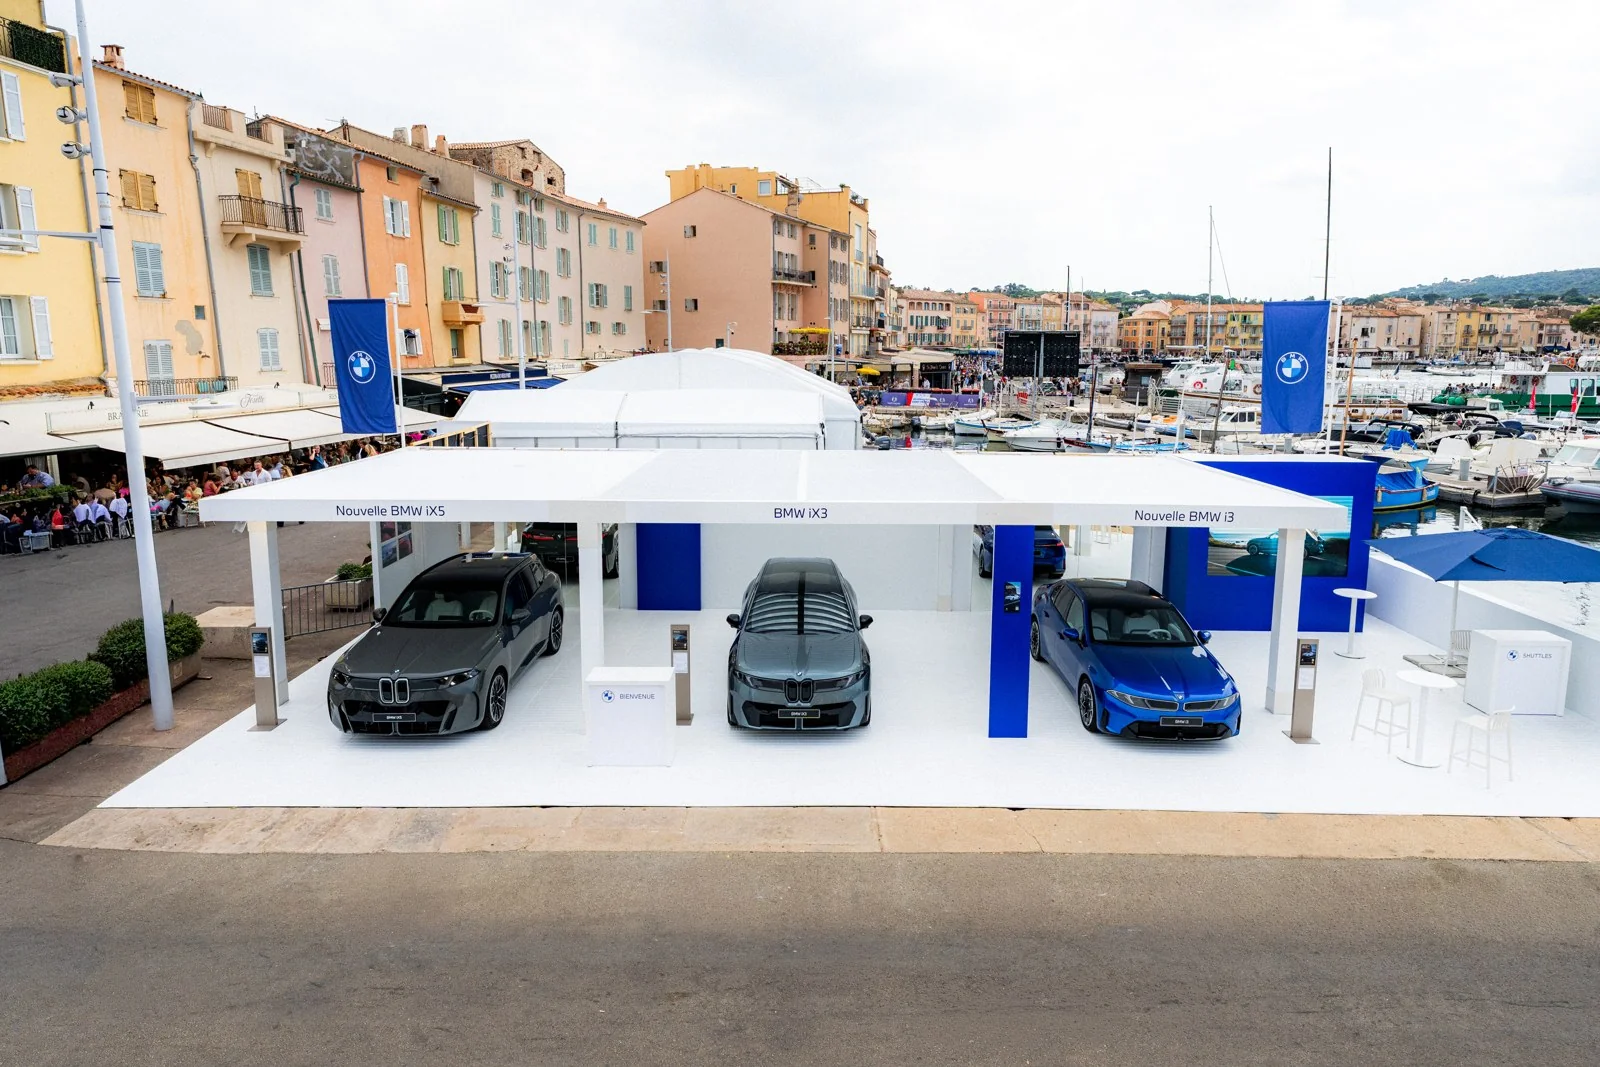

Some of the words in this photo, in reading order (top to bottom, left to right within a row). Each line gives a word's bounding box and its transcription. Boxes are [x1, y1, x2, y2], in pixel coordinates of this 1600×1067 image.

[350, 352, 371, 362] BMW
[1280, 353, 1305, 363] BMW
[107, 409, 149, 421] BRARIE
[336, 505, 387, 516] Nouvelle
[391, 505, 423, 516] BMW
[426, 505, 446, 517] iX5
[774, 507, 806, 519] BMW
[808, 507, 828, 519] iX3
[1134, 510, 1186, 521] Nouvelle
[1189, 511, 1222, 522] BMW
[1224, 511, 1235, 523] i3
